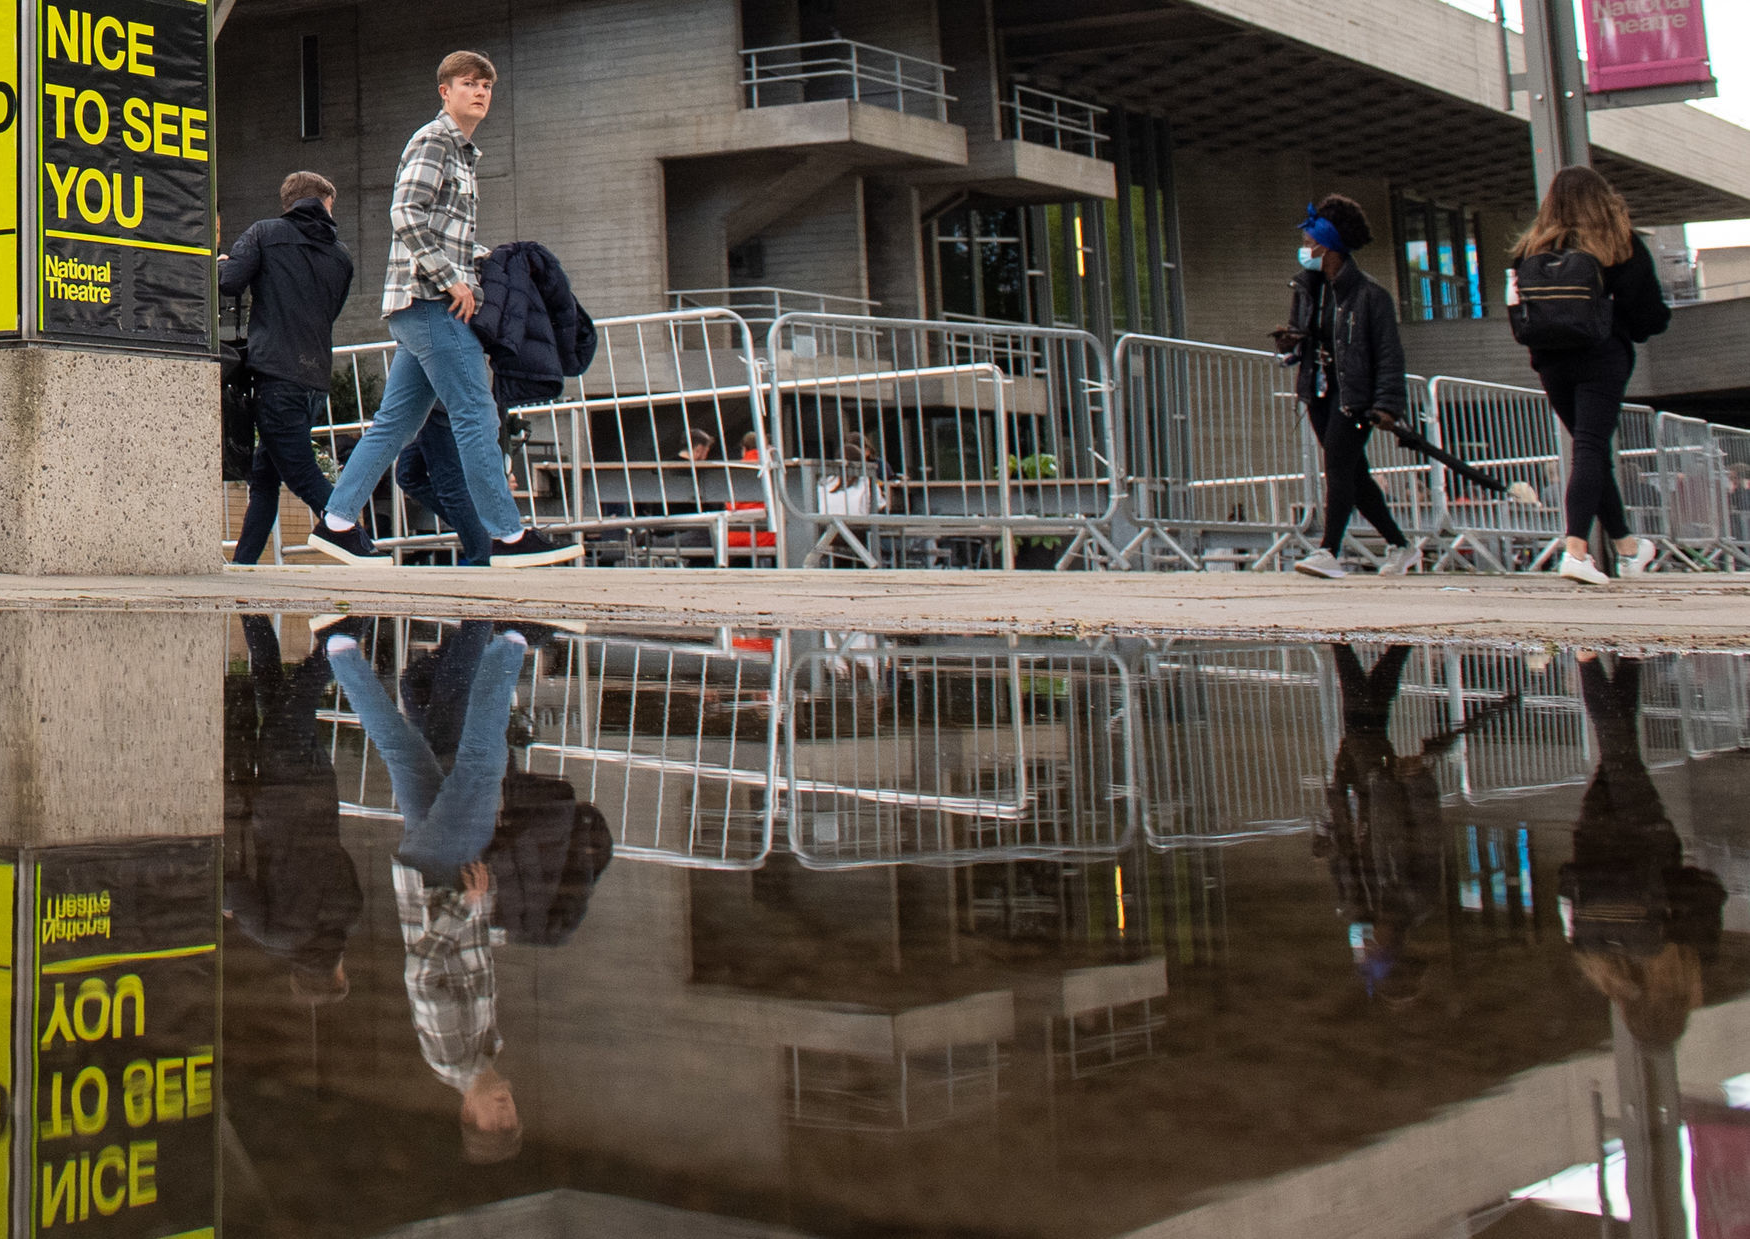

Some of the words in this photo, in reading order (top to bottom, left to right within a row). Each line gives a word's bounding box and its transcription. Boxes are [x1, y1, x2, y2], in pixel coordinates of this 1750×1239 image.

[47, 5, 155, 78] NICE
[45, 83, 109, 146] TO
[123, 97, 209, 162] SEE
[45, 162, 144, 229] YOU
[45, 255, 111, 283] National
[46, 277, 111, 304] Theatre
